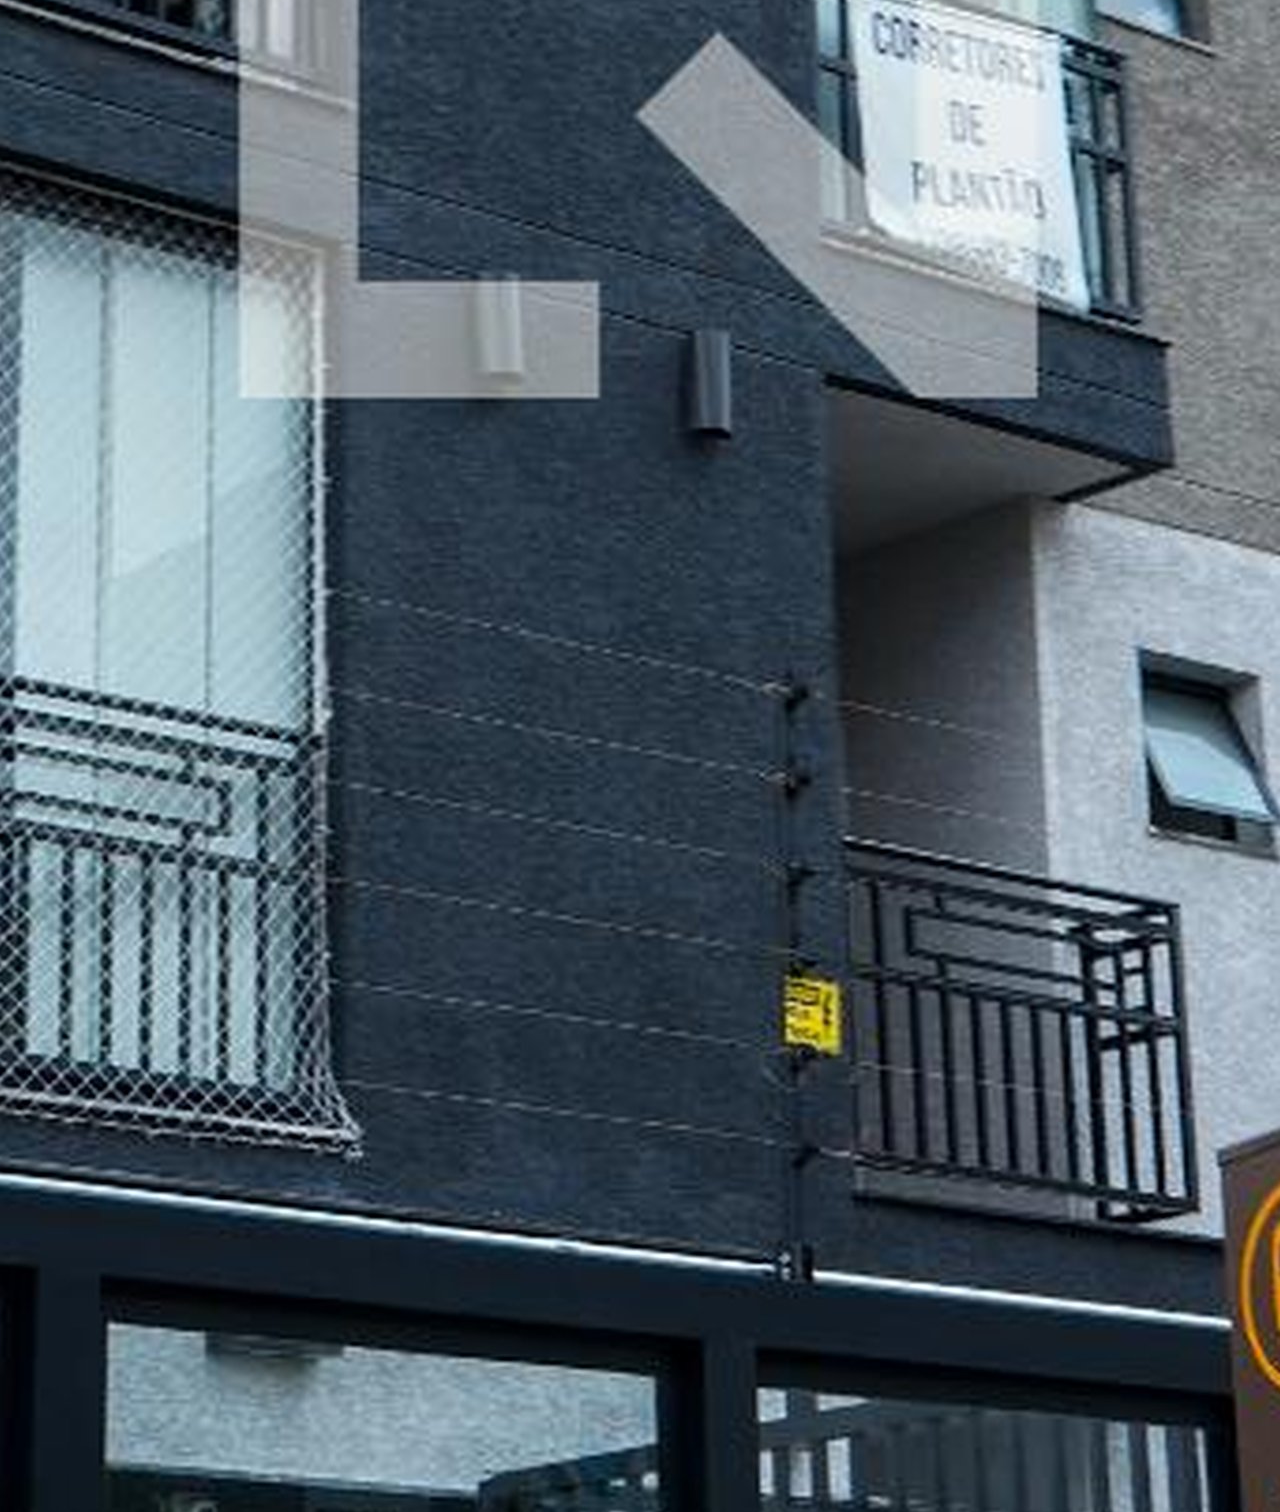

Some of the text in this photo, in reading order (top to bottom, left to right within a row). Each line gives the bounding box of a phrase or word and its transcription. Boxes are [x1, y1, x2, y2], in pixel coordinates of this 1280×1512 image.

[872, 12, 1046, 92] CORRETORES
[948, 99, 986, 147] DE
[909, 158, 1048, 221] PLANTÃO
